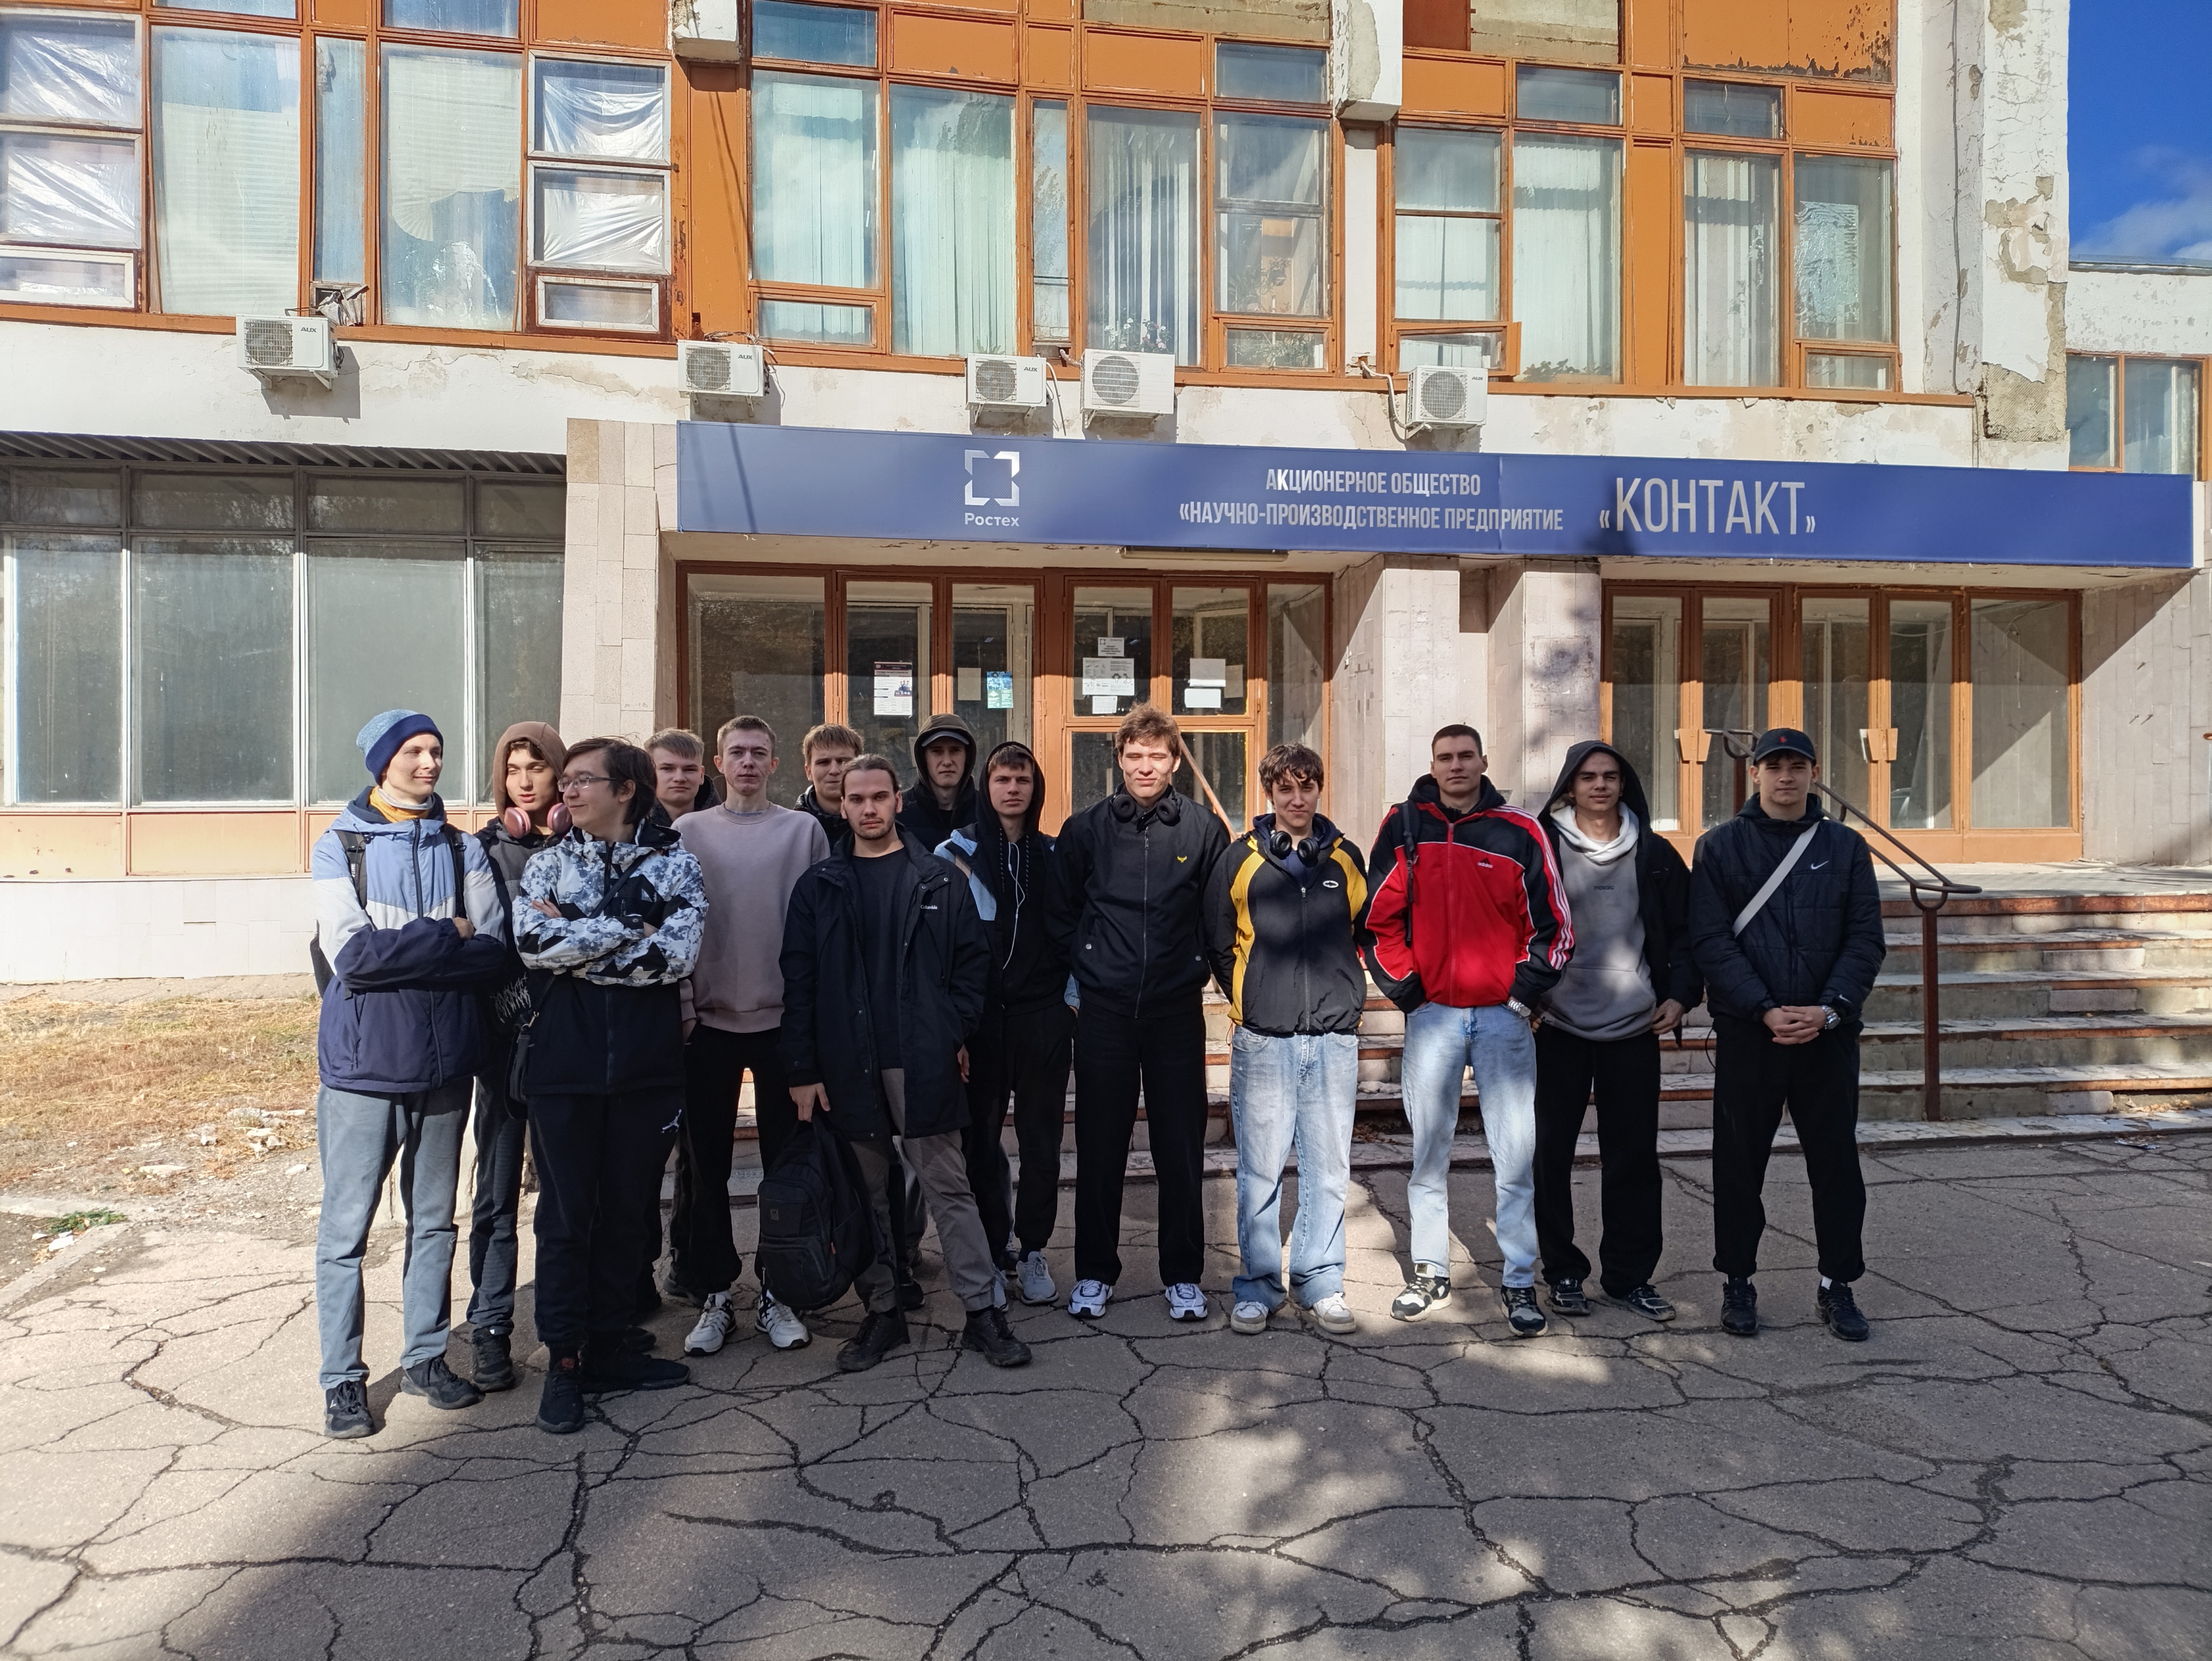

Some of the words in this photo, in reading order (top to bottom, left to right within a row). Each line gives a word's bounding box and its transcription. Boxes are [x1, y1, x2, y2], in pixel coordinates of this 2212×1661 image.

[1266, 469, 1387, 493] АКЦИОНЕРНОЕ
[1391, 473, 1481, 497] ОБЩЕСТВО
[965, 512, 1020, 527] Ростех
[1179, 501, 1440, 530] «НАУЧНО-ПРОИЗВОДСТВЕННОЕ
[1445, 508, 1563, 532] ПРЕДПРИЯТИЕ
[1599, 477, 1816, 534] «КОНТАКТ»
